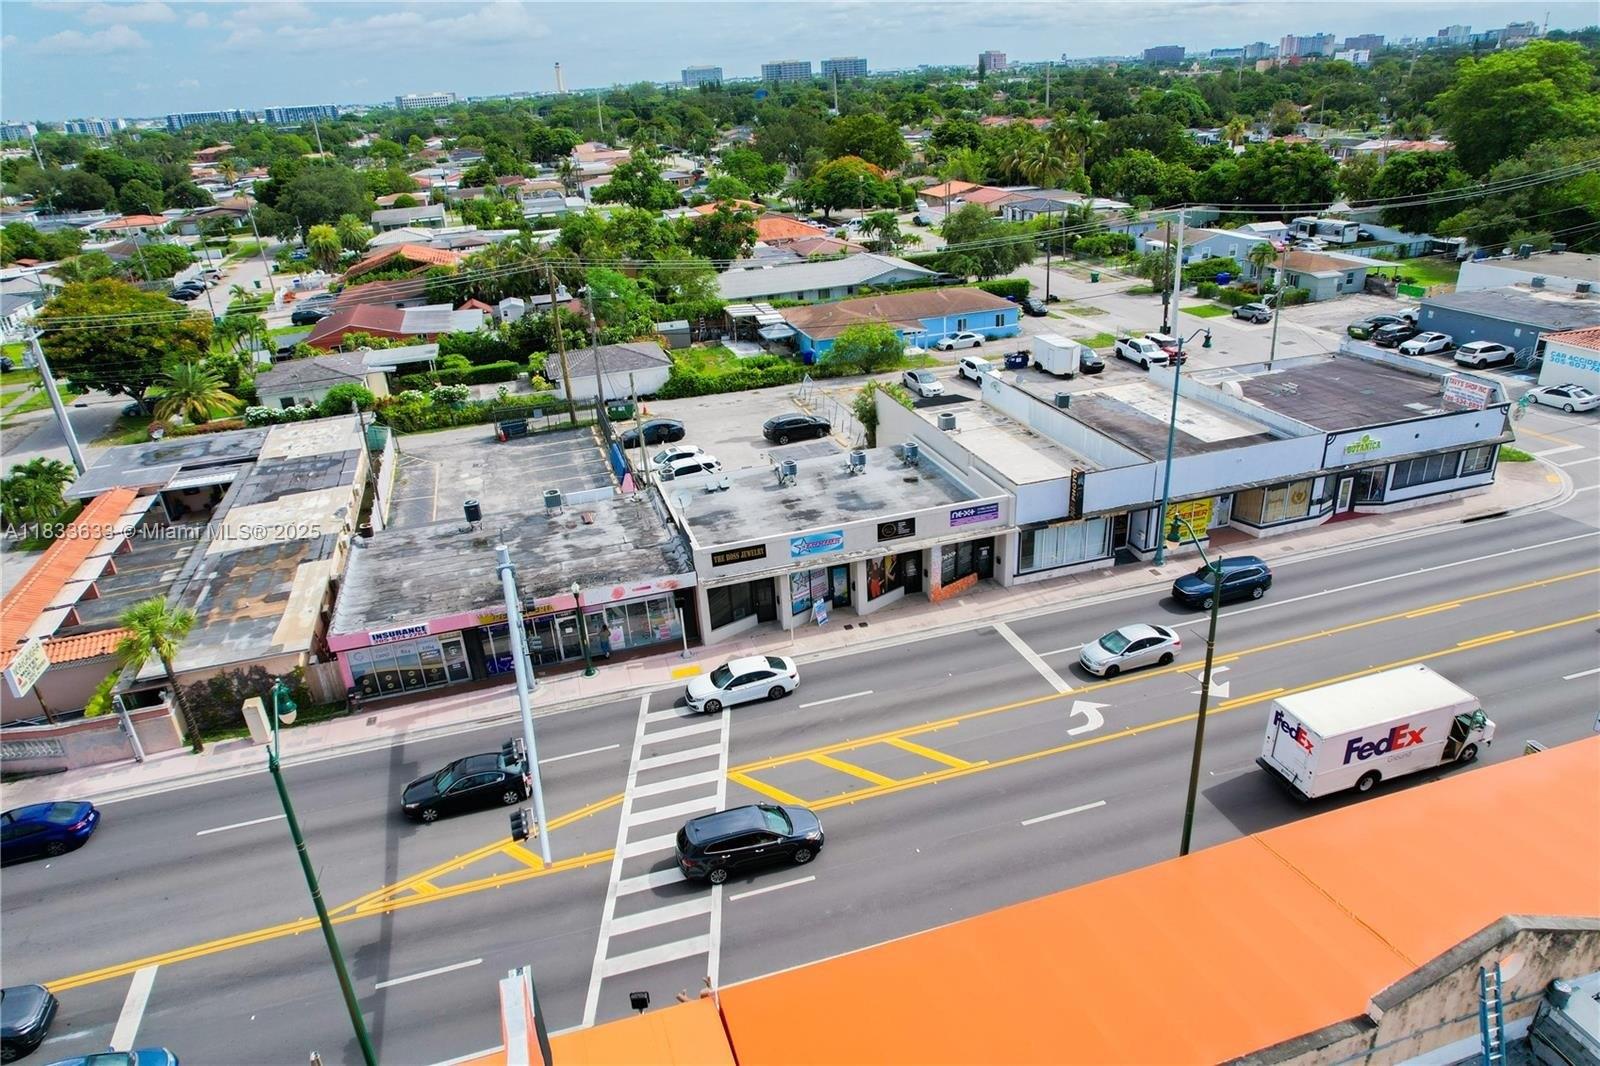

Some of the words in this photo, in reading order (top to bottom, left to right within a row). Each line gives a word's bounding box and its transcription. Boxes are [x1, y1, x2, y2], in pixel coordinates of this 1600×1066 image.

[1568, 355, 1600, 367] ACCIDE
[1345, 440, 1381, 454] BOTANICA
[713, 554, 726, 564] THE
[725, 551, 740, 562] BOSS
[740, 547, 765, 559] JEWELRY
[371, 625, 426, 640] INSURANCE
[1273, 710, 1314, 755] FedEx
[1343, 723, 1428, 765] FedEx
